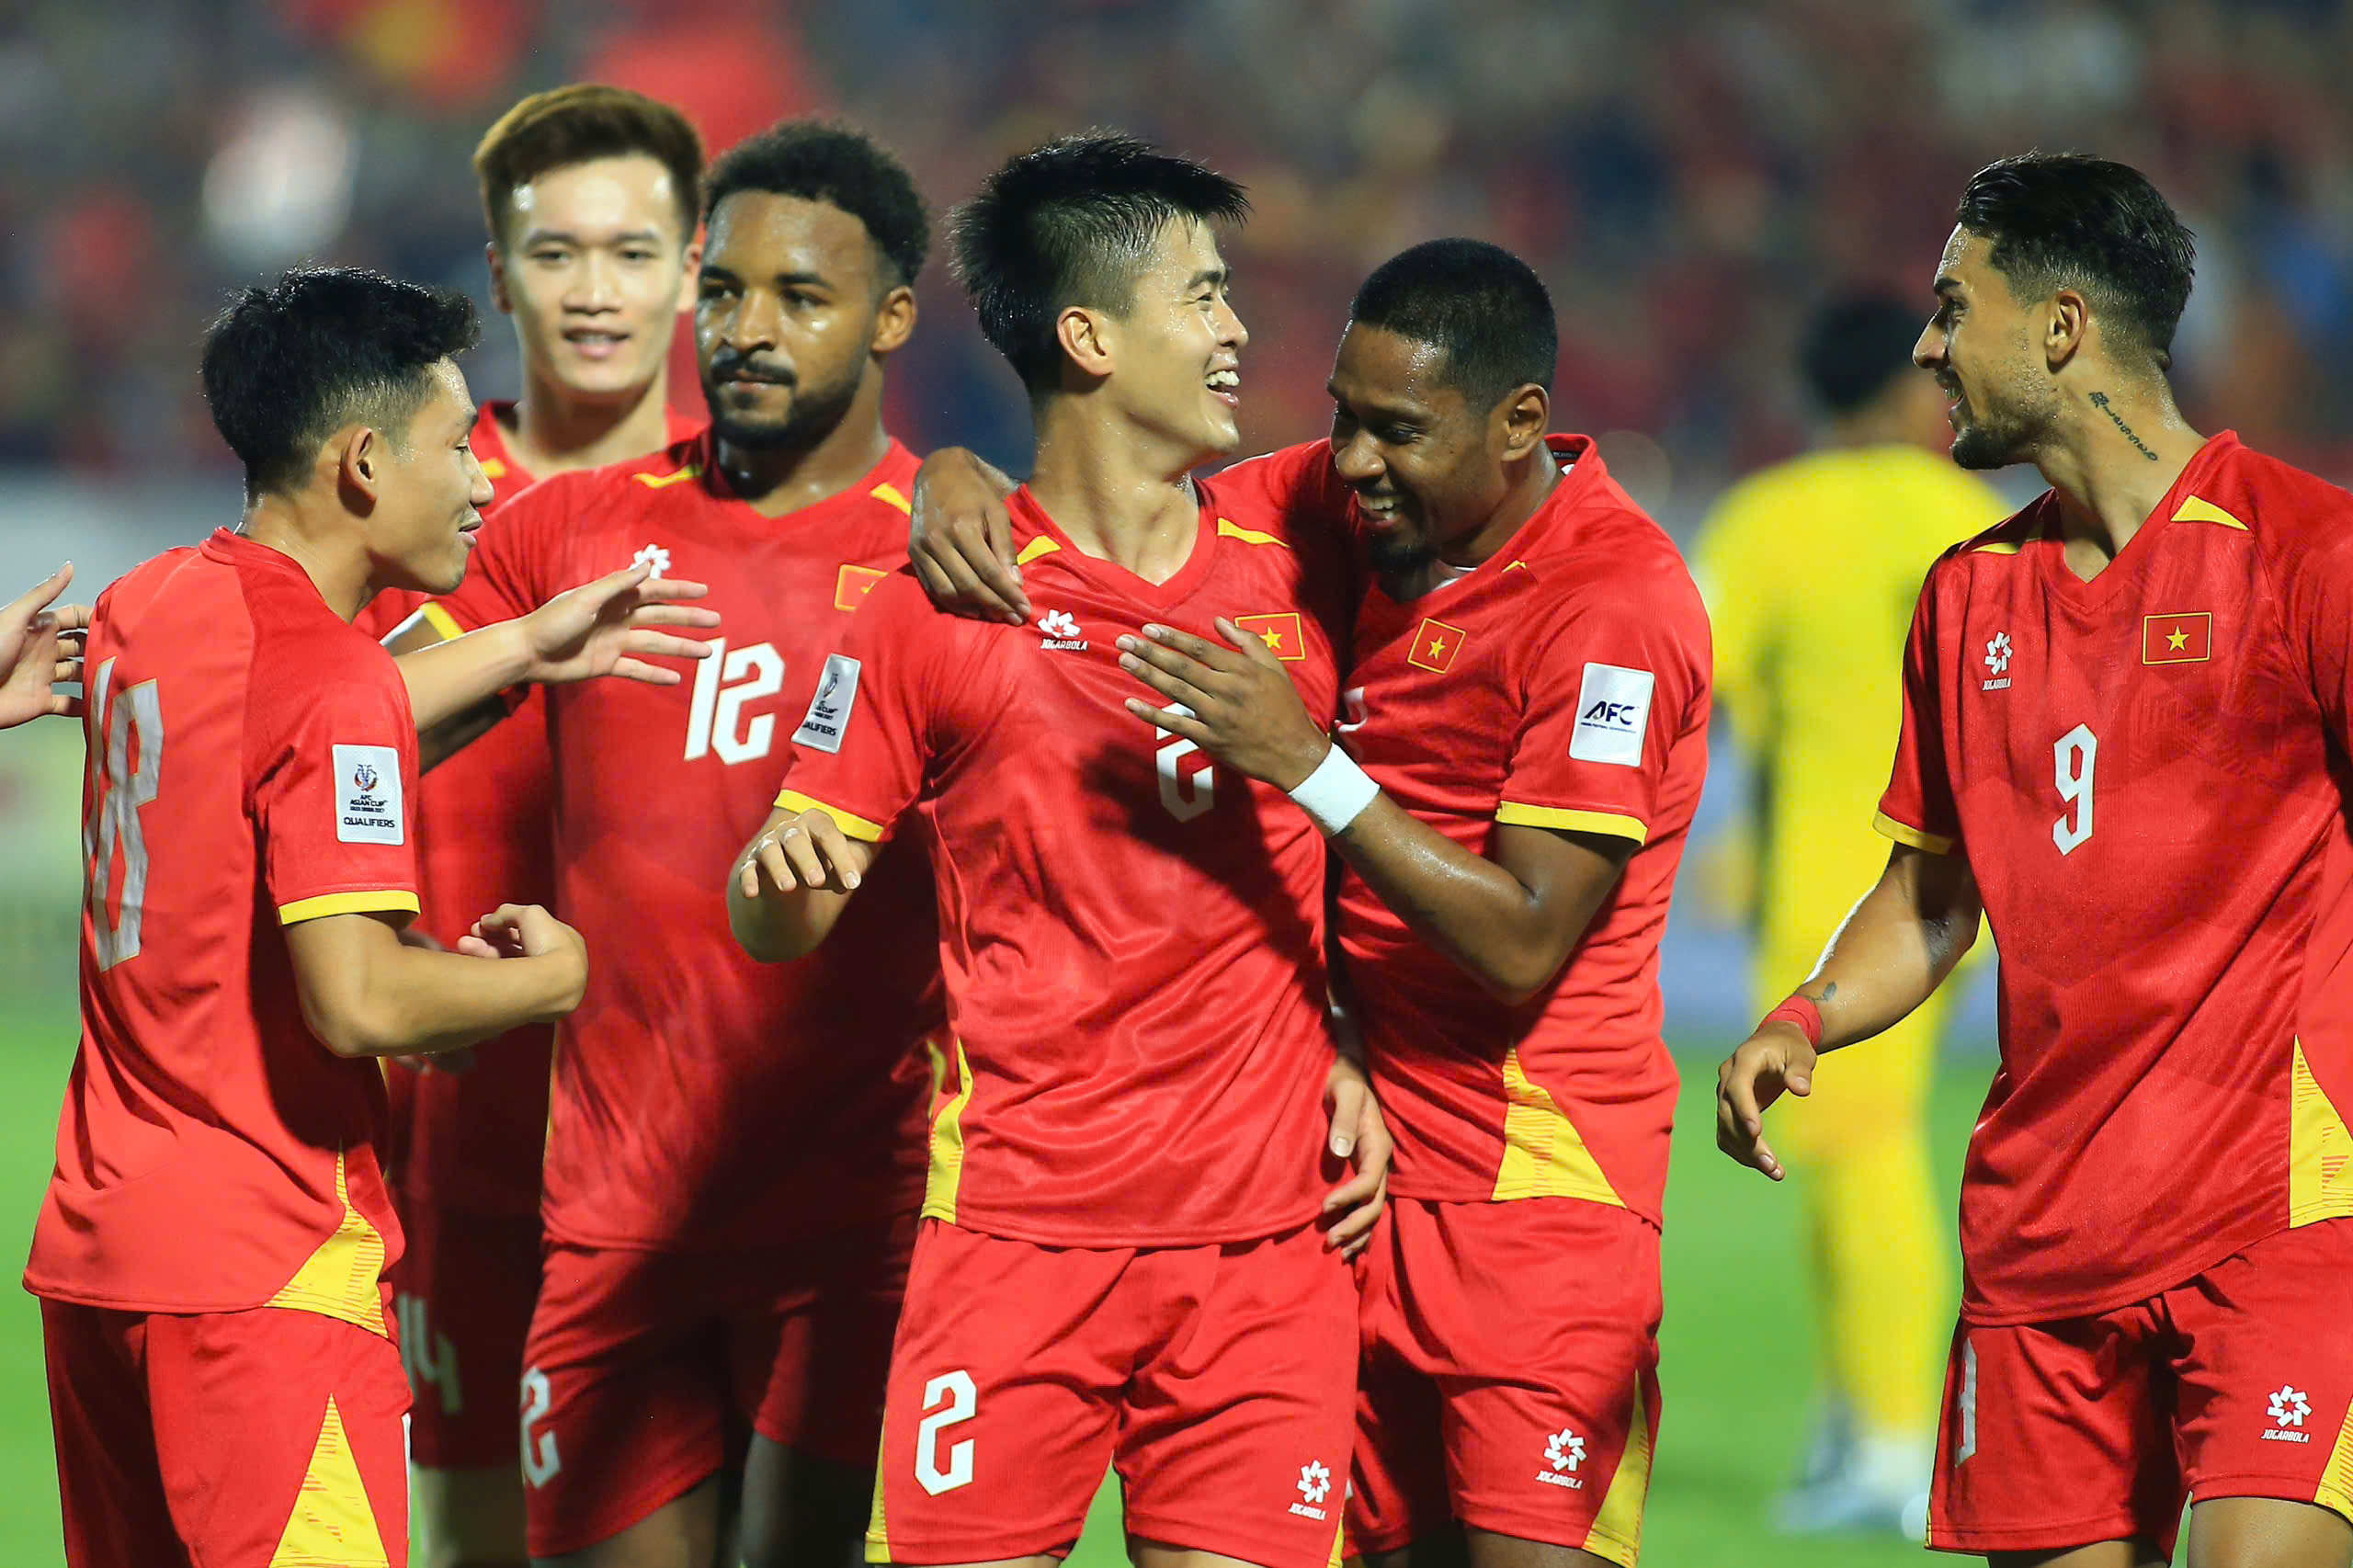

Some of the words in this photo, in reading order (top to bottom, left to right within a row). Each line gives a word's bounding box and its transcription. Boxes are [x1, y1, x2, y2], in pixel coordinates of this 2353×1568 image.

[683, 636, 787, 767] 12
[1040, 638, 1088, 651] JOGARBOLA
[1155, 702, 1214, 824] 2
[1584, 700, 1636, 726] AFC
[84, 653, 164, 973] 18
[344, 816, 395, 828] QUALIFIERS
[2052, 721, 2099, 858] 9
[914, 1369, 978, 1497] 2
[2260, 1428, 2311, 1444] JOGARBOLA
